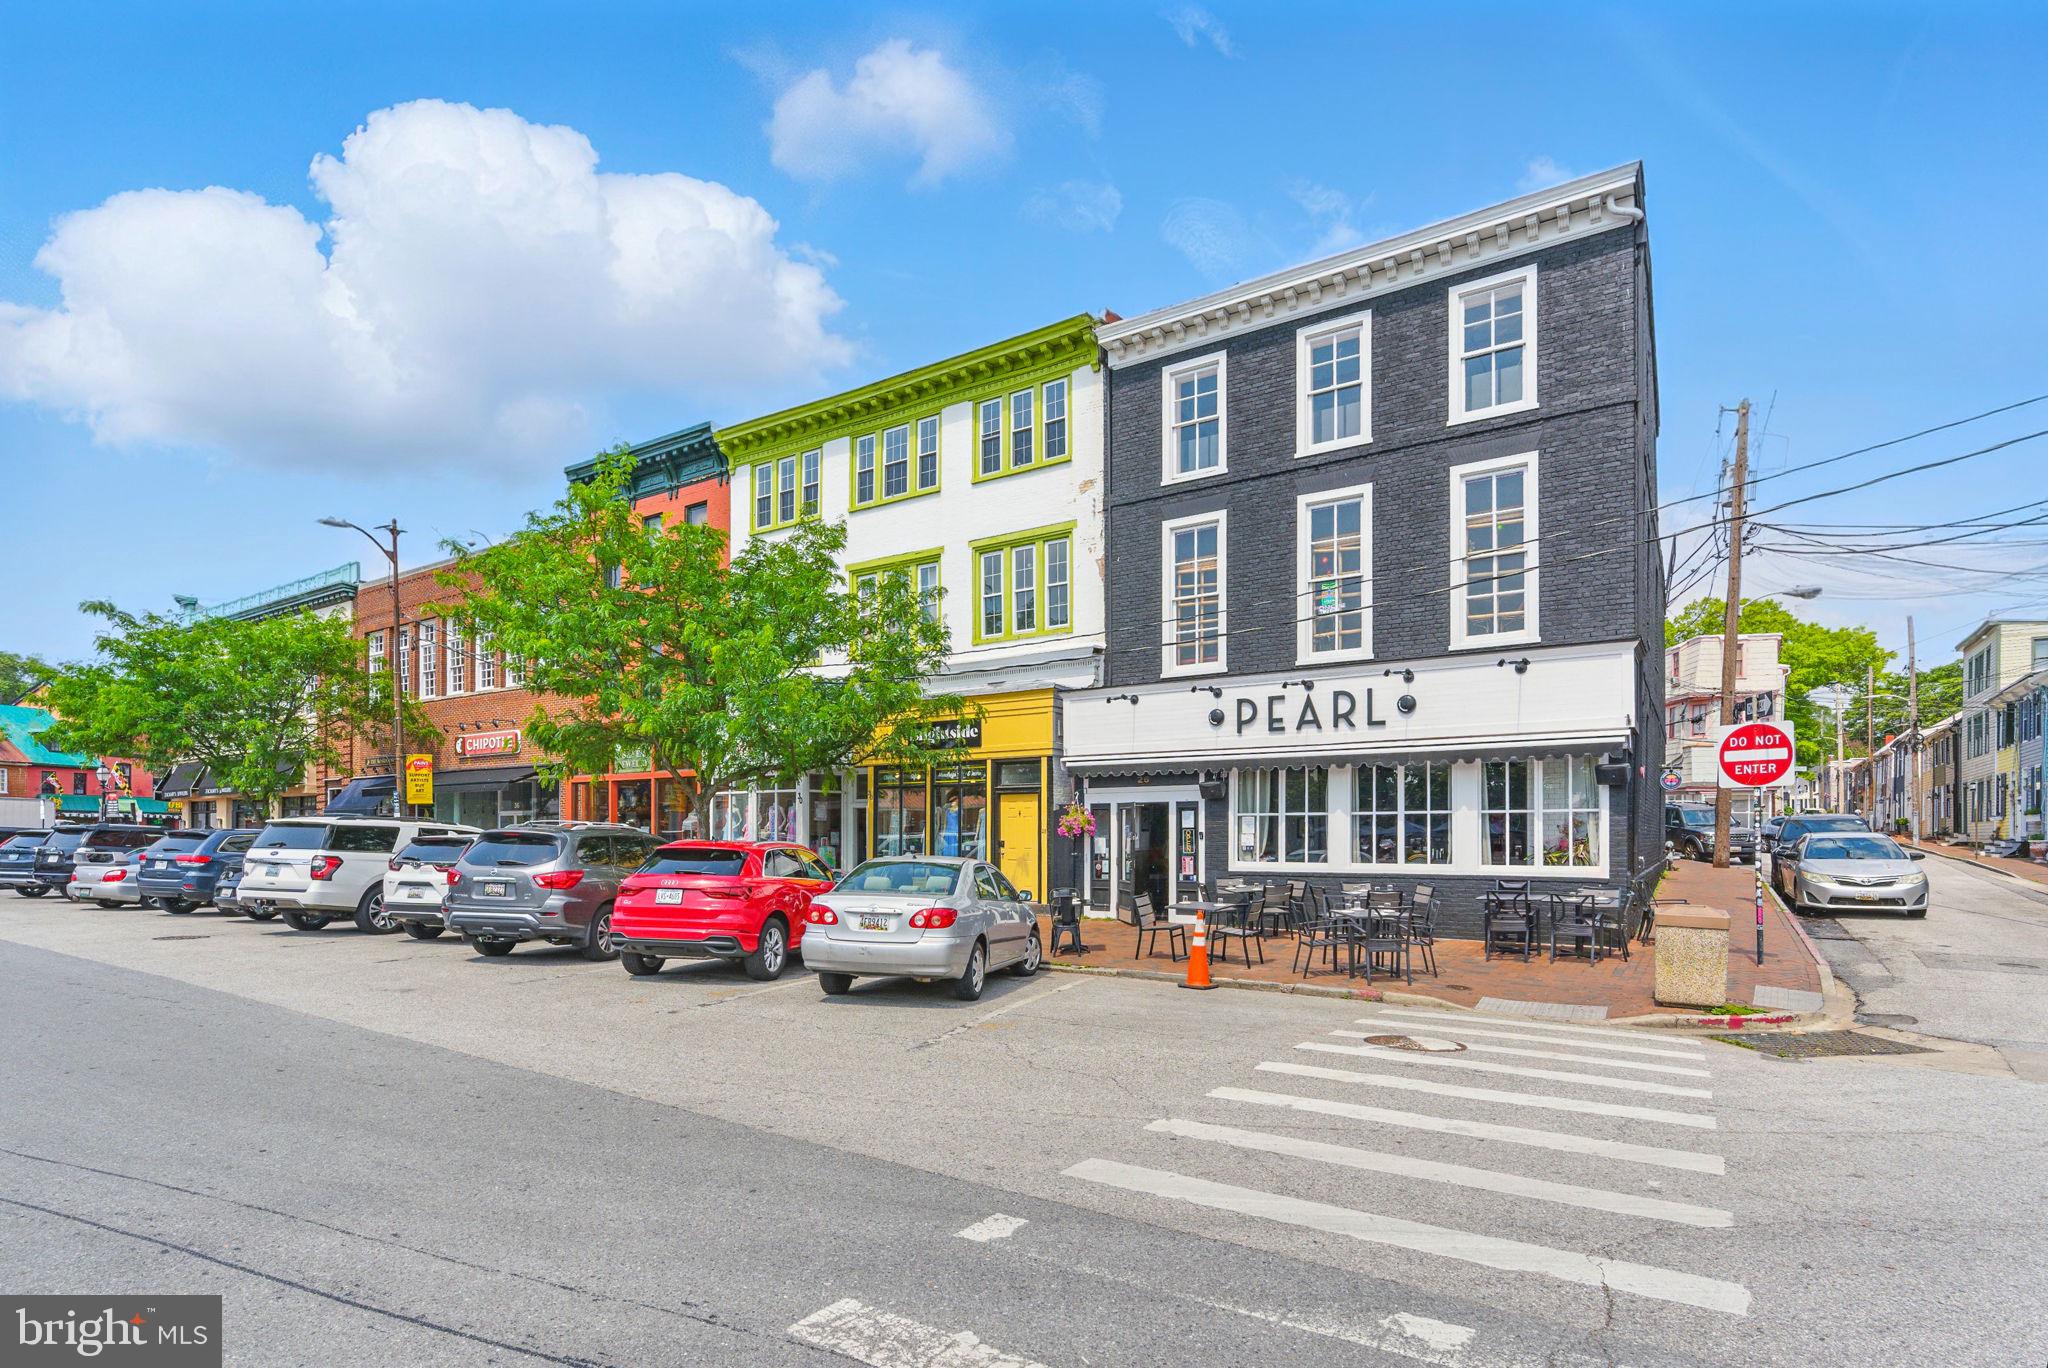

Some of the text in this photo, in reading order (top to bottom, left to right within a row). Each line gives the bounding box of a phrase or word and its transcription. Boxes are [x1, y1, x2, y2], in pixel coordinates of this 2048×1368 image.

[1237, 688, 1386, 734] PEARL
[1729, 734, 1781, 748] DO NOT
[1735, 763, 1776, 775] ENTER
